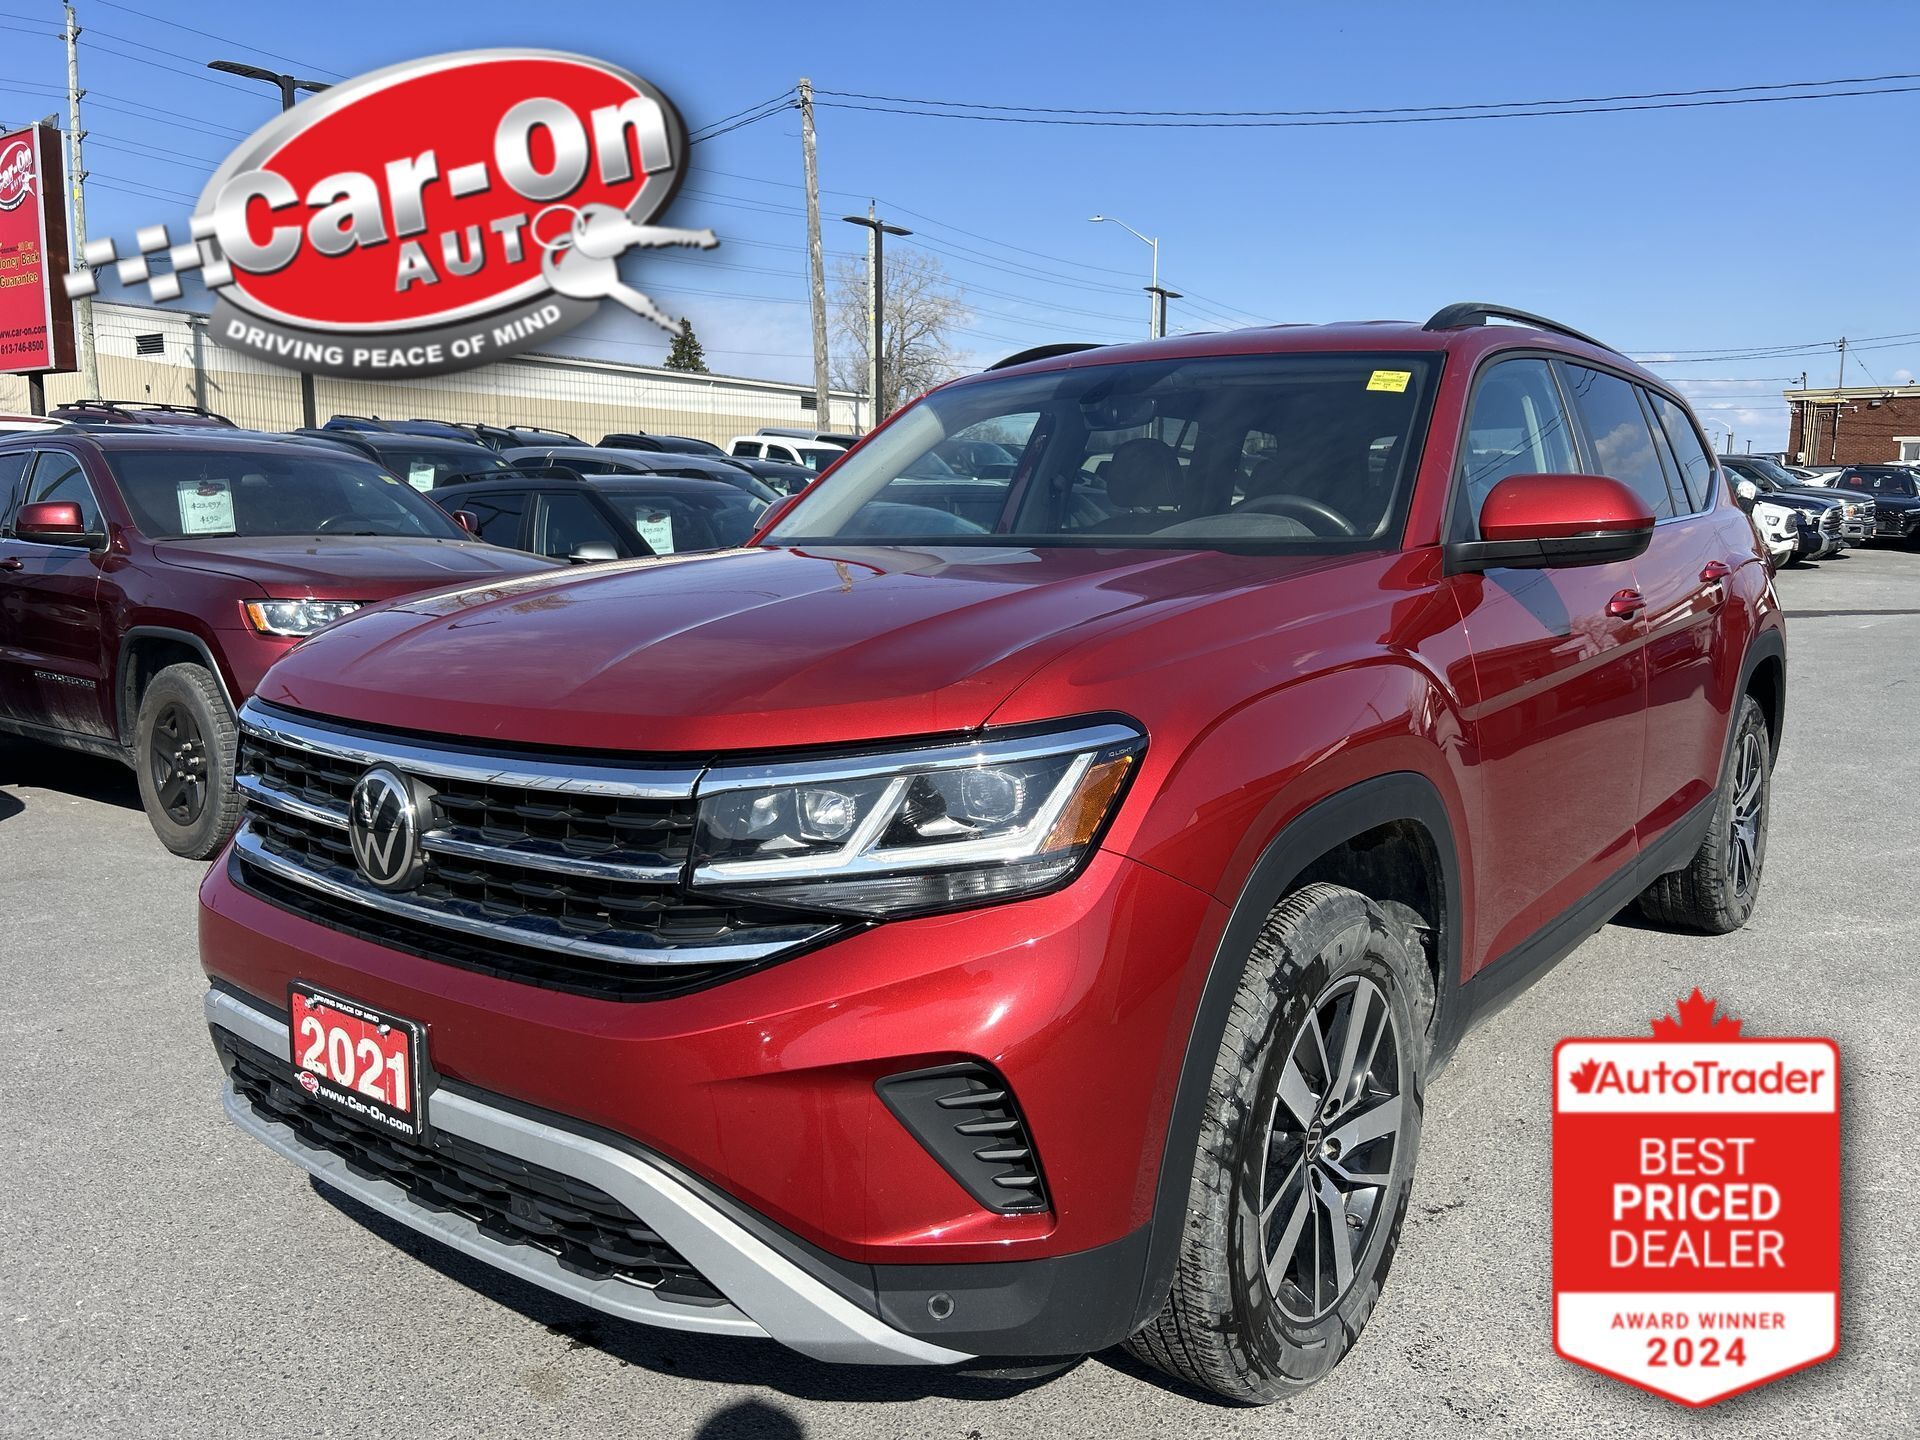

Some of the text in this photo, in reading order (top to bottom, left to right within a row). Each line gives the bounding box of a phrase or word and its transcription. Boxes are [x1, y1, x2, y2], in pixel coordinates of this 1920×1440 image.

[0, 250, 40, 271] oney Back
[0, 271, 38, 288] Guarantee
[301, 1016, 406, 1112] 2021
[320, 1085, 413, 1135] www.Car-On.com
